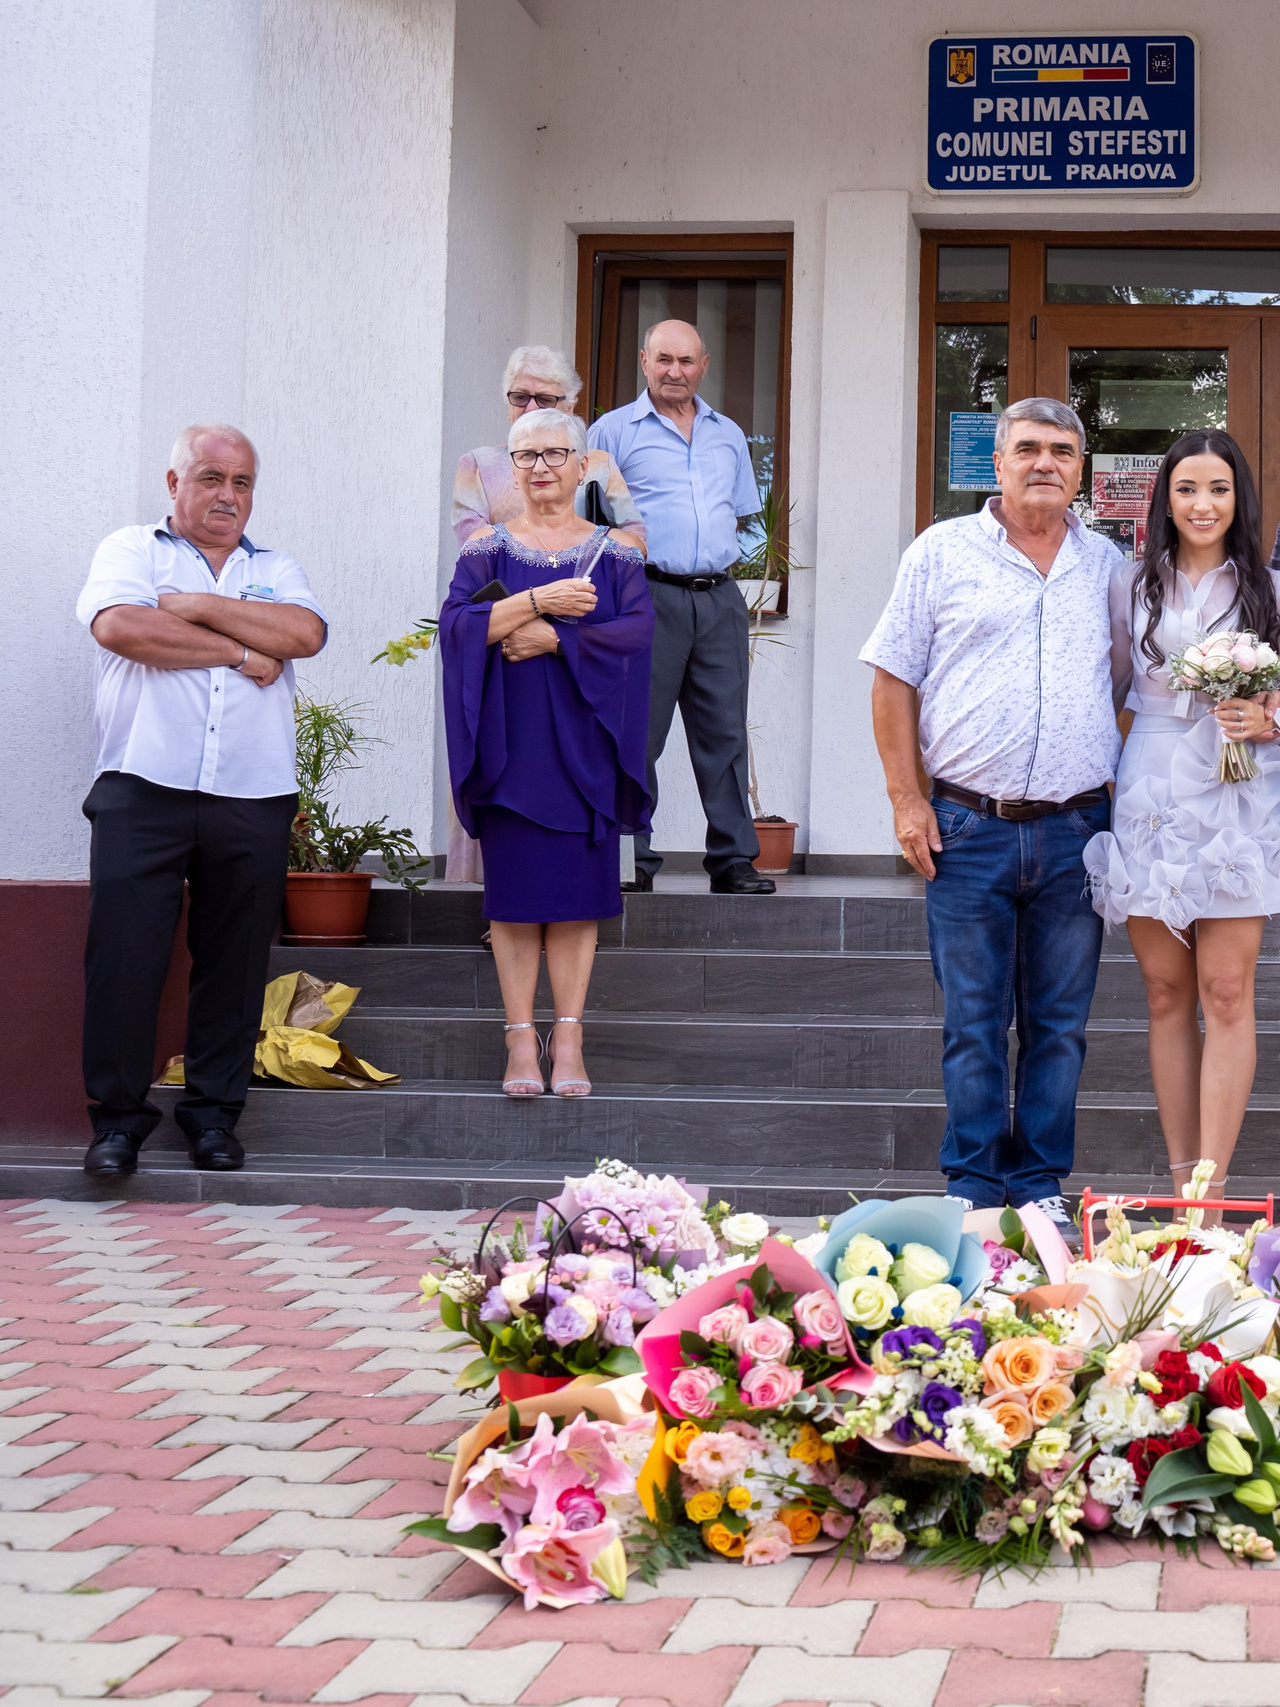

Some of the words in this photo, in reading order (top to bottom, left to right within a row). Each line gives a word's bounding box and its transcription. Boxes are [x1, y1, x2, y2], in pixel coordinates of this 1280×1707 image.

[992, 43, 1130, 65] ROMANIA
[973, 96, 1149, 122] PRIMARIA
[936, 132, 1052, 157] COMUNEI
[1068, 130, 1186, 156] STEFESTI
[946, 165, 1052, 182] JUDETUL
[1066, 163, 1176, 180] PRAHOVA
